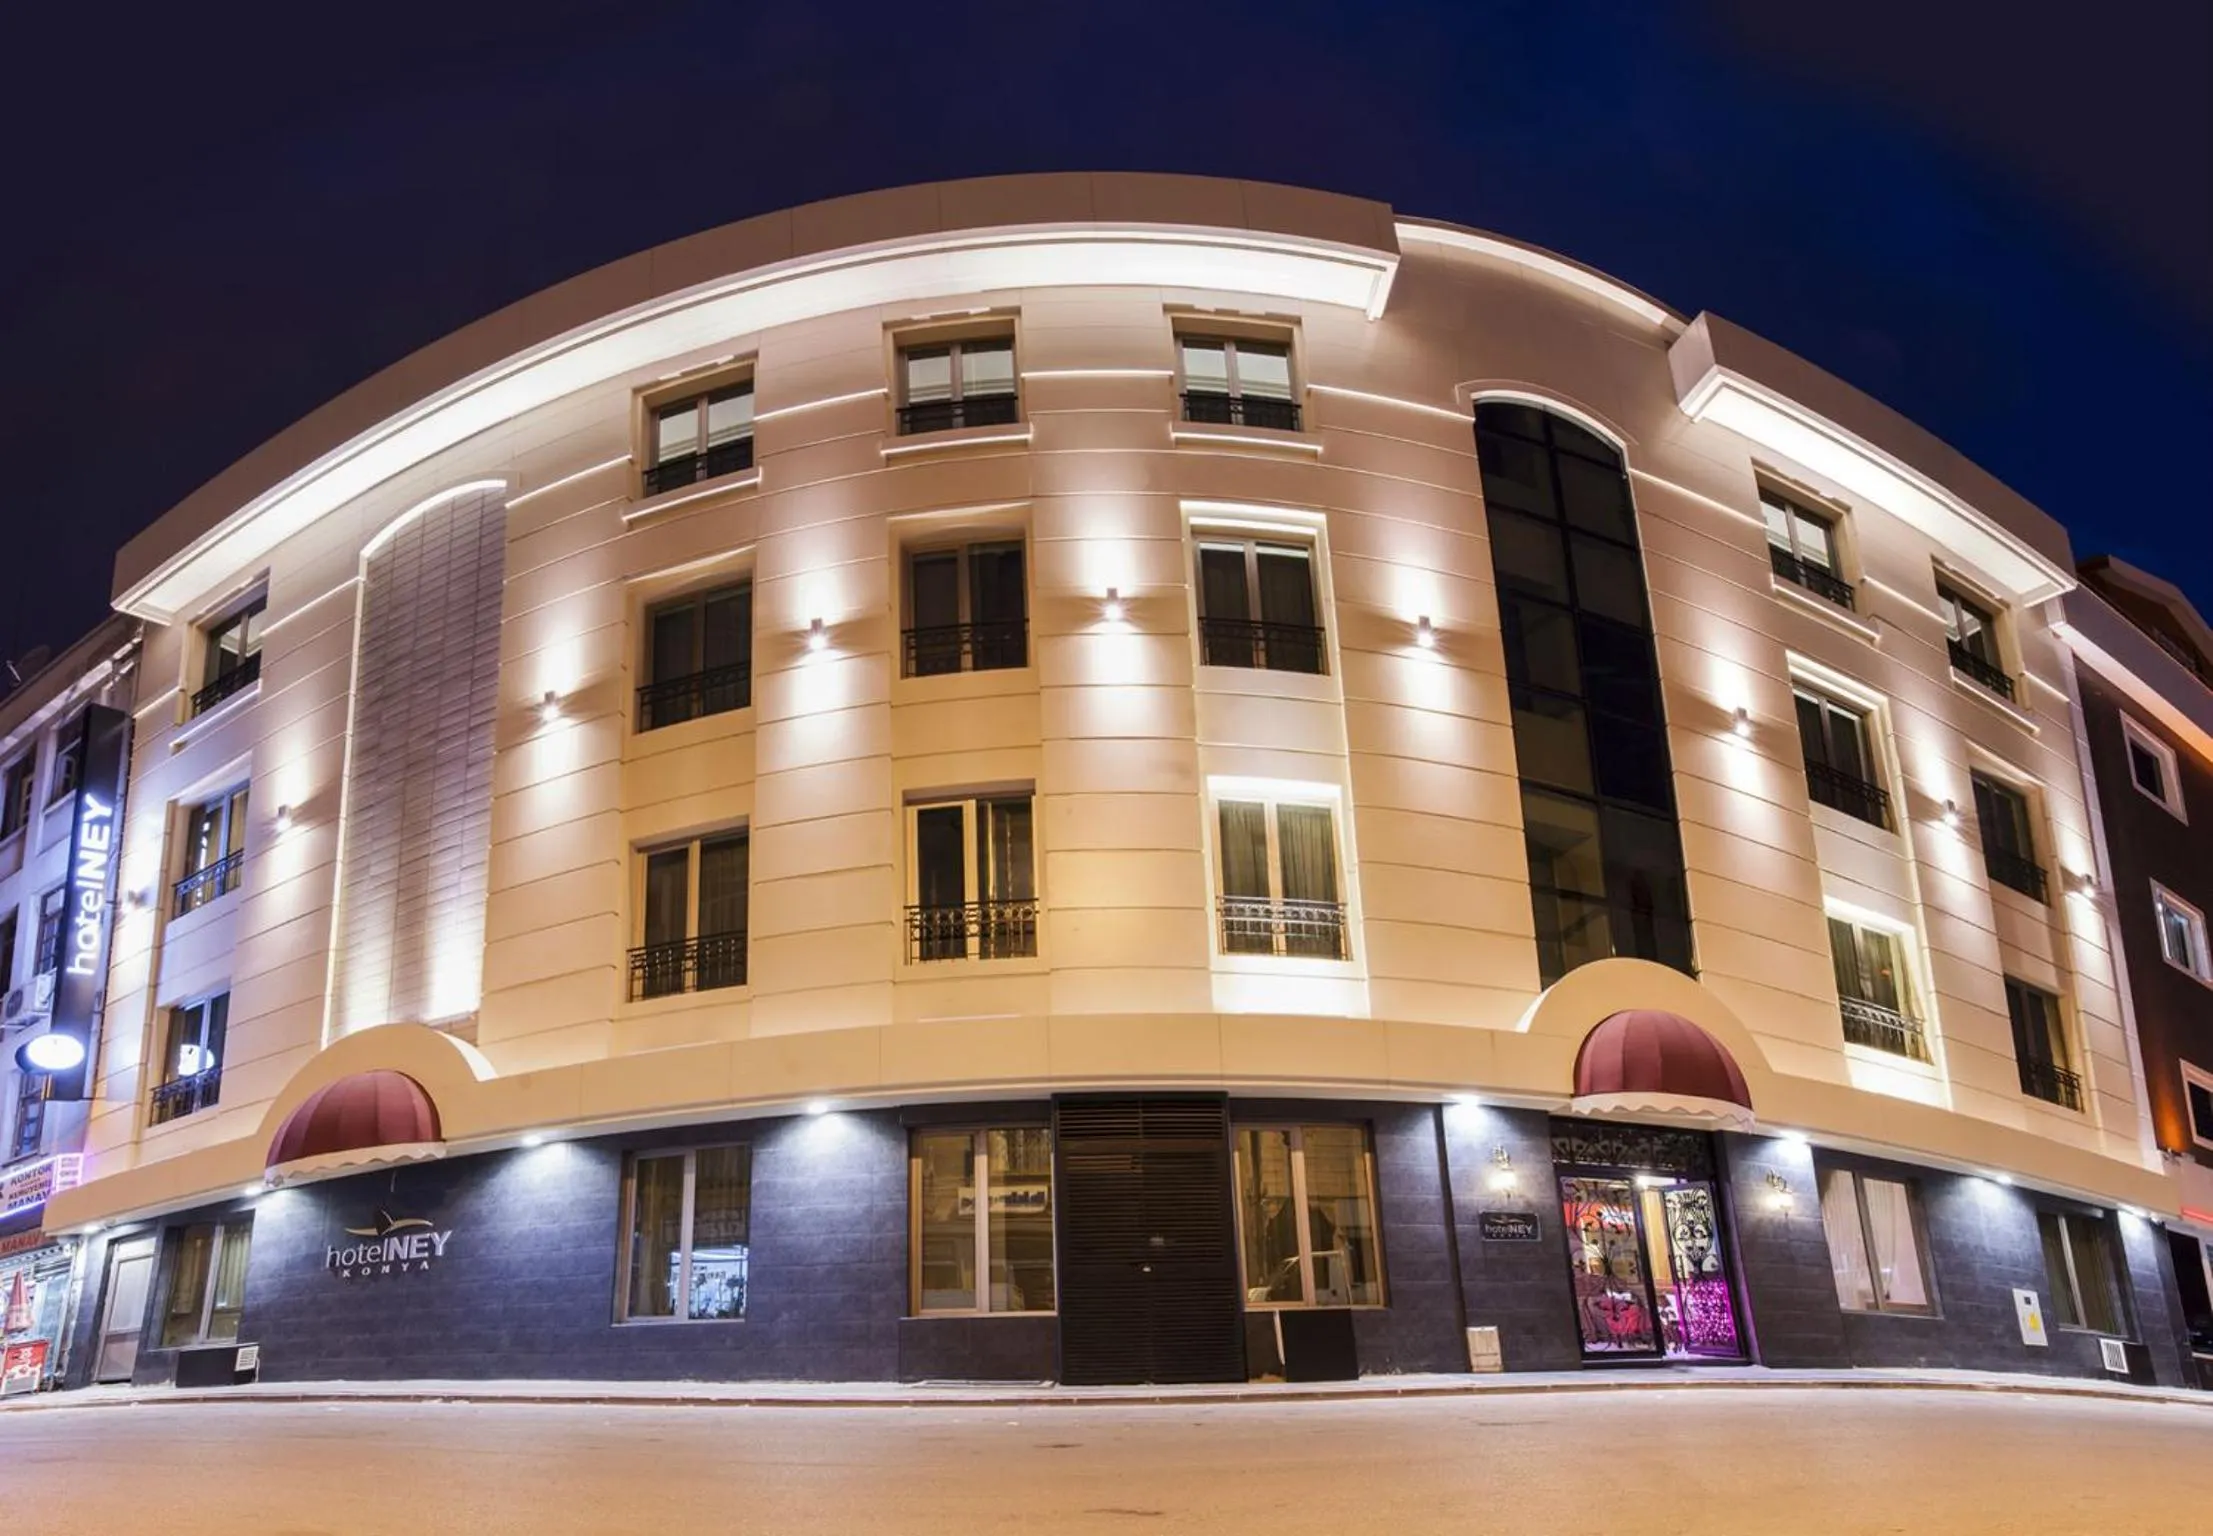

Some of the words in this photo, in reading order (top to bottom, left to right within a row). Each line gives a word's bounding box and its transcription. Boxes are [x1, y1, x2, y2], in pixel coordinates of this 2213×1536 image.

[66, 792, 113, 976] hotelNEY
[325, 1230, 453, 1269] hotelNEY
[342, 1260, 430, 1278] KONYA
